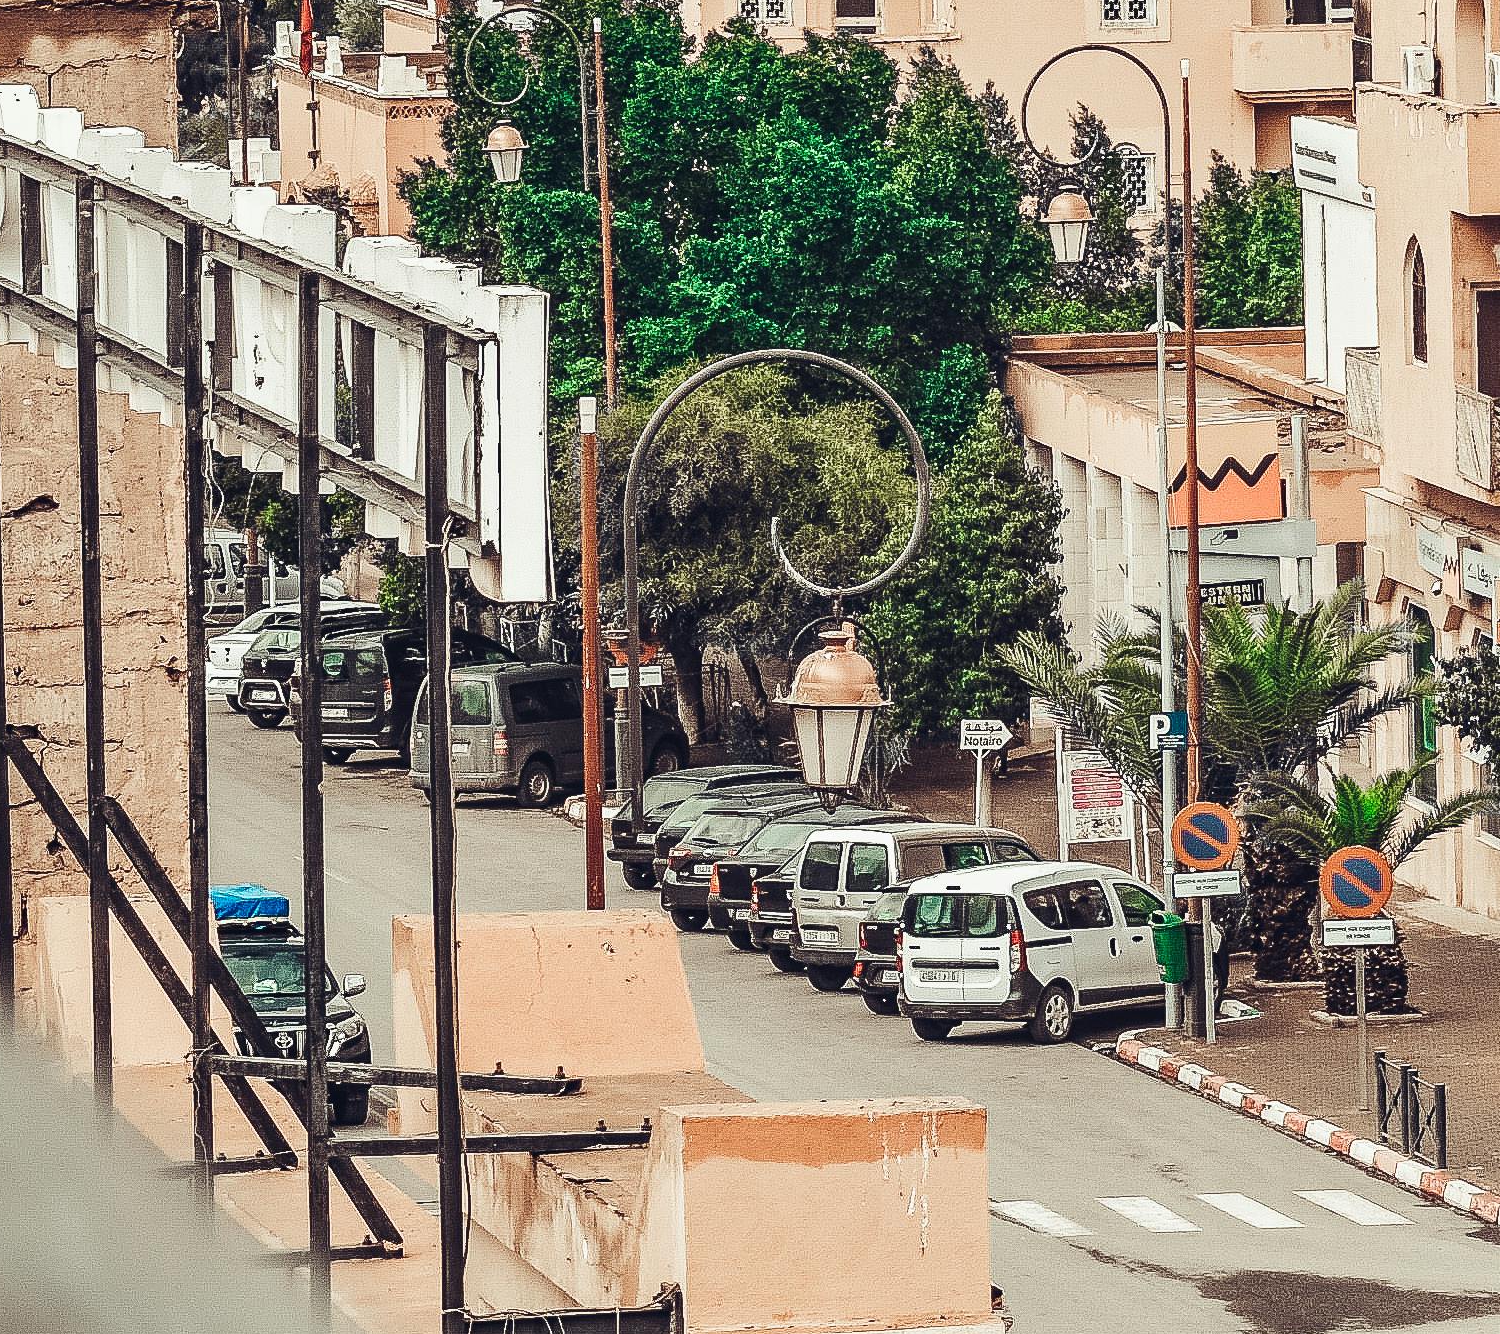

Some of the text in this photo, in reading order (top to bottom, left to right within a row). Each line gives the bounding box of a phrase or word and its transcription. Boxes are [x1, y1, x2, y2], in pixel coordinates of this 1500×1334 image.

[1200, 584, 1251, 597] ESTERN
[1208, 593, 1252, 605] UNON
[1150, 714, 1171, 749] P
[964, 735, 1003, 747] Notaire
